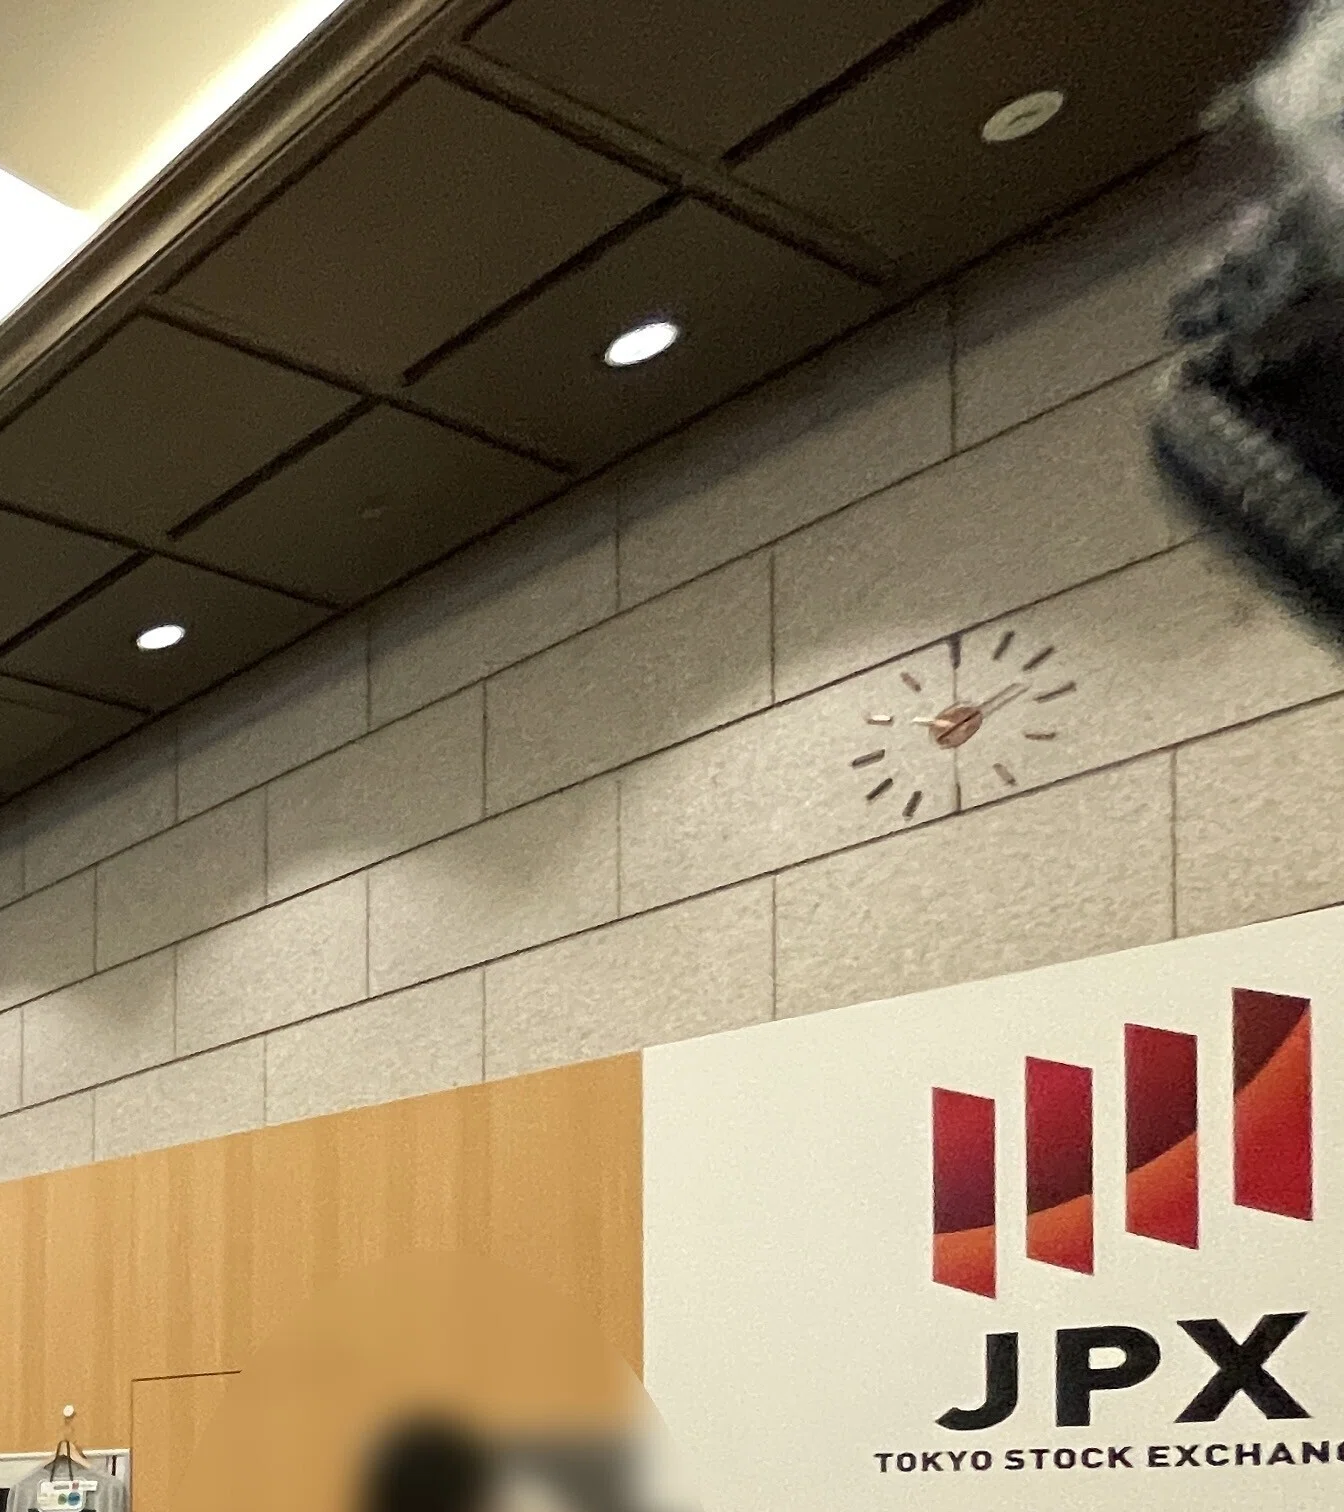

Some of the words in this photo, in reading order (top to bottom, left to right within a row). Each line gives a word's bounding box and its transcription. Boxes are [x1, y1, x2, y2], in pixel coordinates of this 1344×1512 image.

[934, 1311, 1312, 1431] JPX
[873, 1450, 993, 1473] TOKYO
[1004, 1446, 1135, 1471] STOCK
